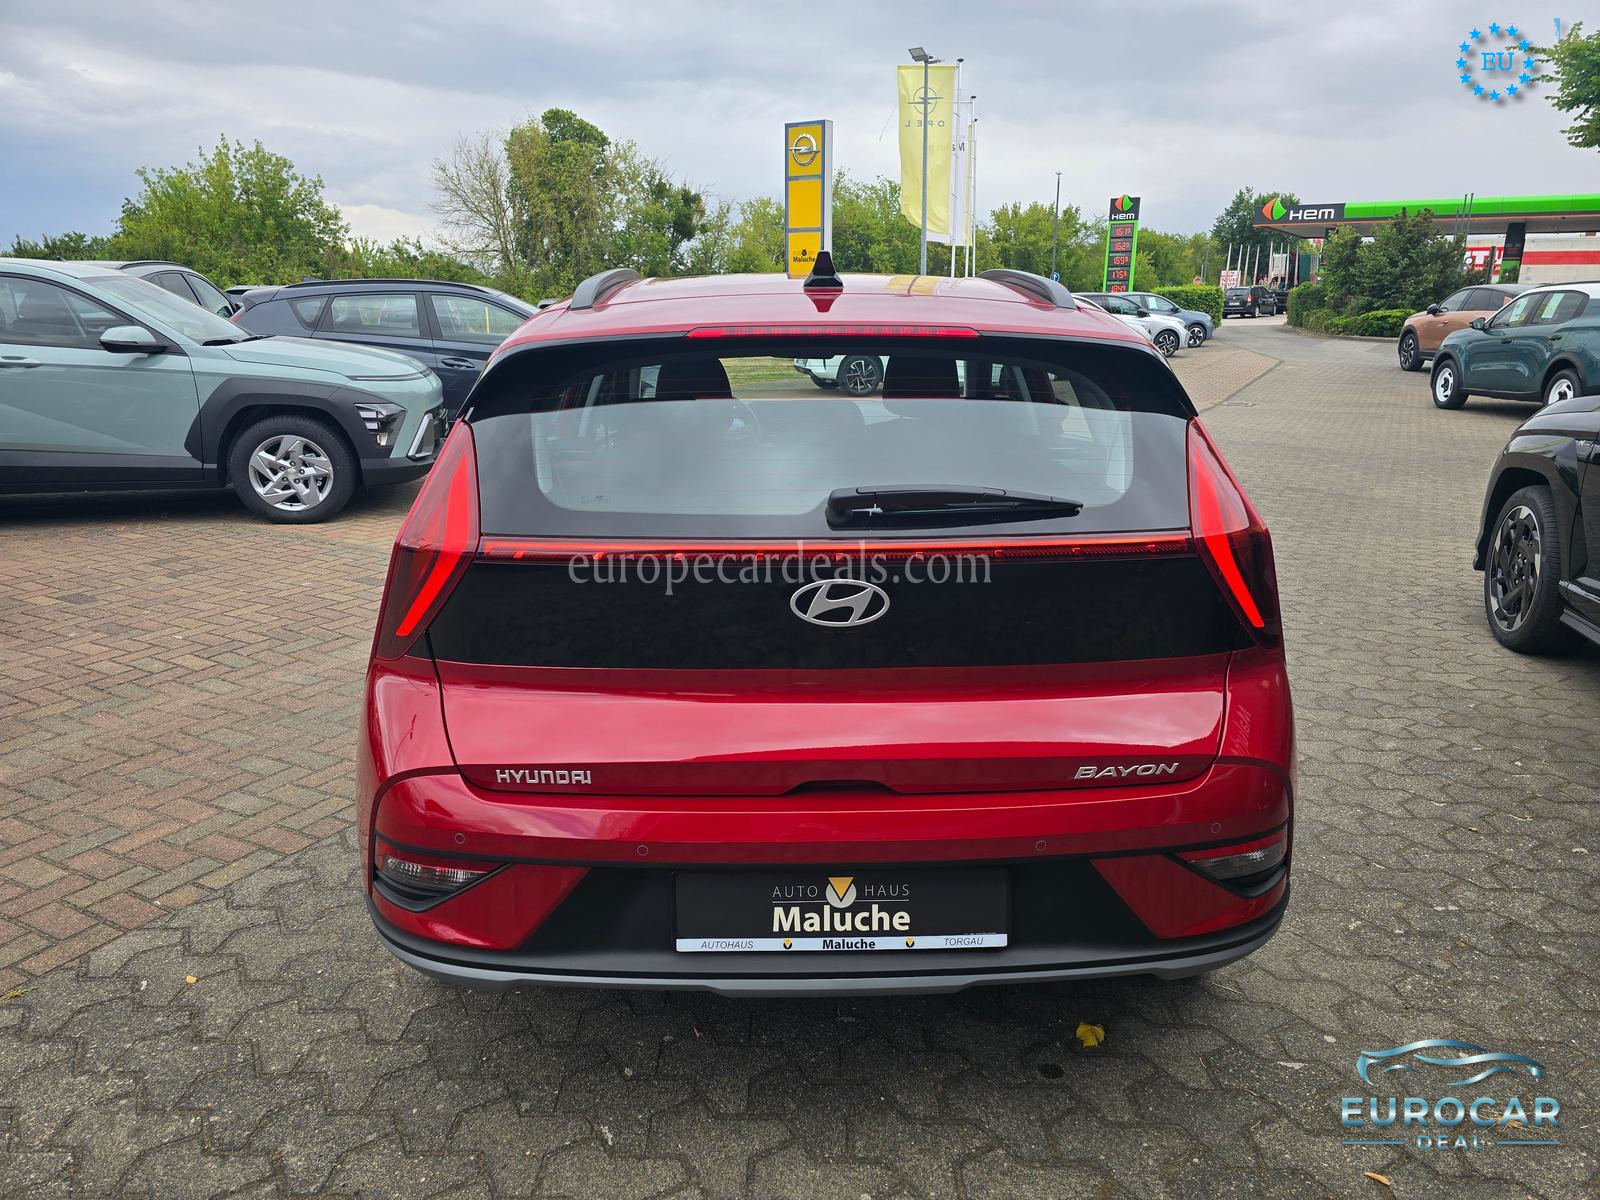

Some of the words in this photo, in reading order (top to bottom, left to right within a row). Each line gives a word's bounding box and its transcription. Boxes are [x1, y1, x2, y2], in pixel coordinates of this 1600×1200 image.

[495, 769, 592, 784] HYUNDAI
[1073, 762, 1179, 780] BAYON
[772, 885, 818, 898] AUTO
[864, 883, 910, 897] HAUS
[772, 903, 911, 933] Maluche
[700, 940, 754, 949] AUTOHAUS
[822, 938, 876, 950] Maluche
[944, 937, 984, 946] TORGAU
